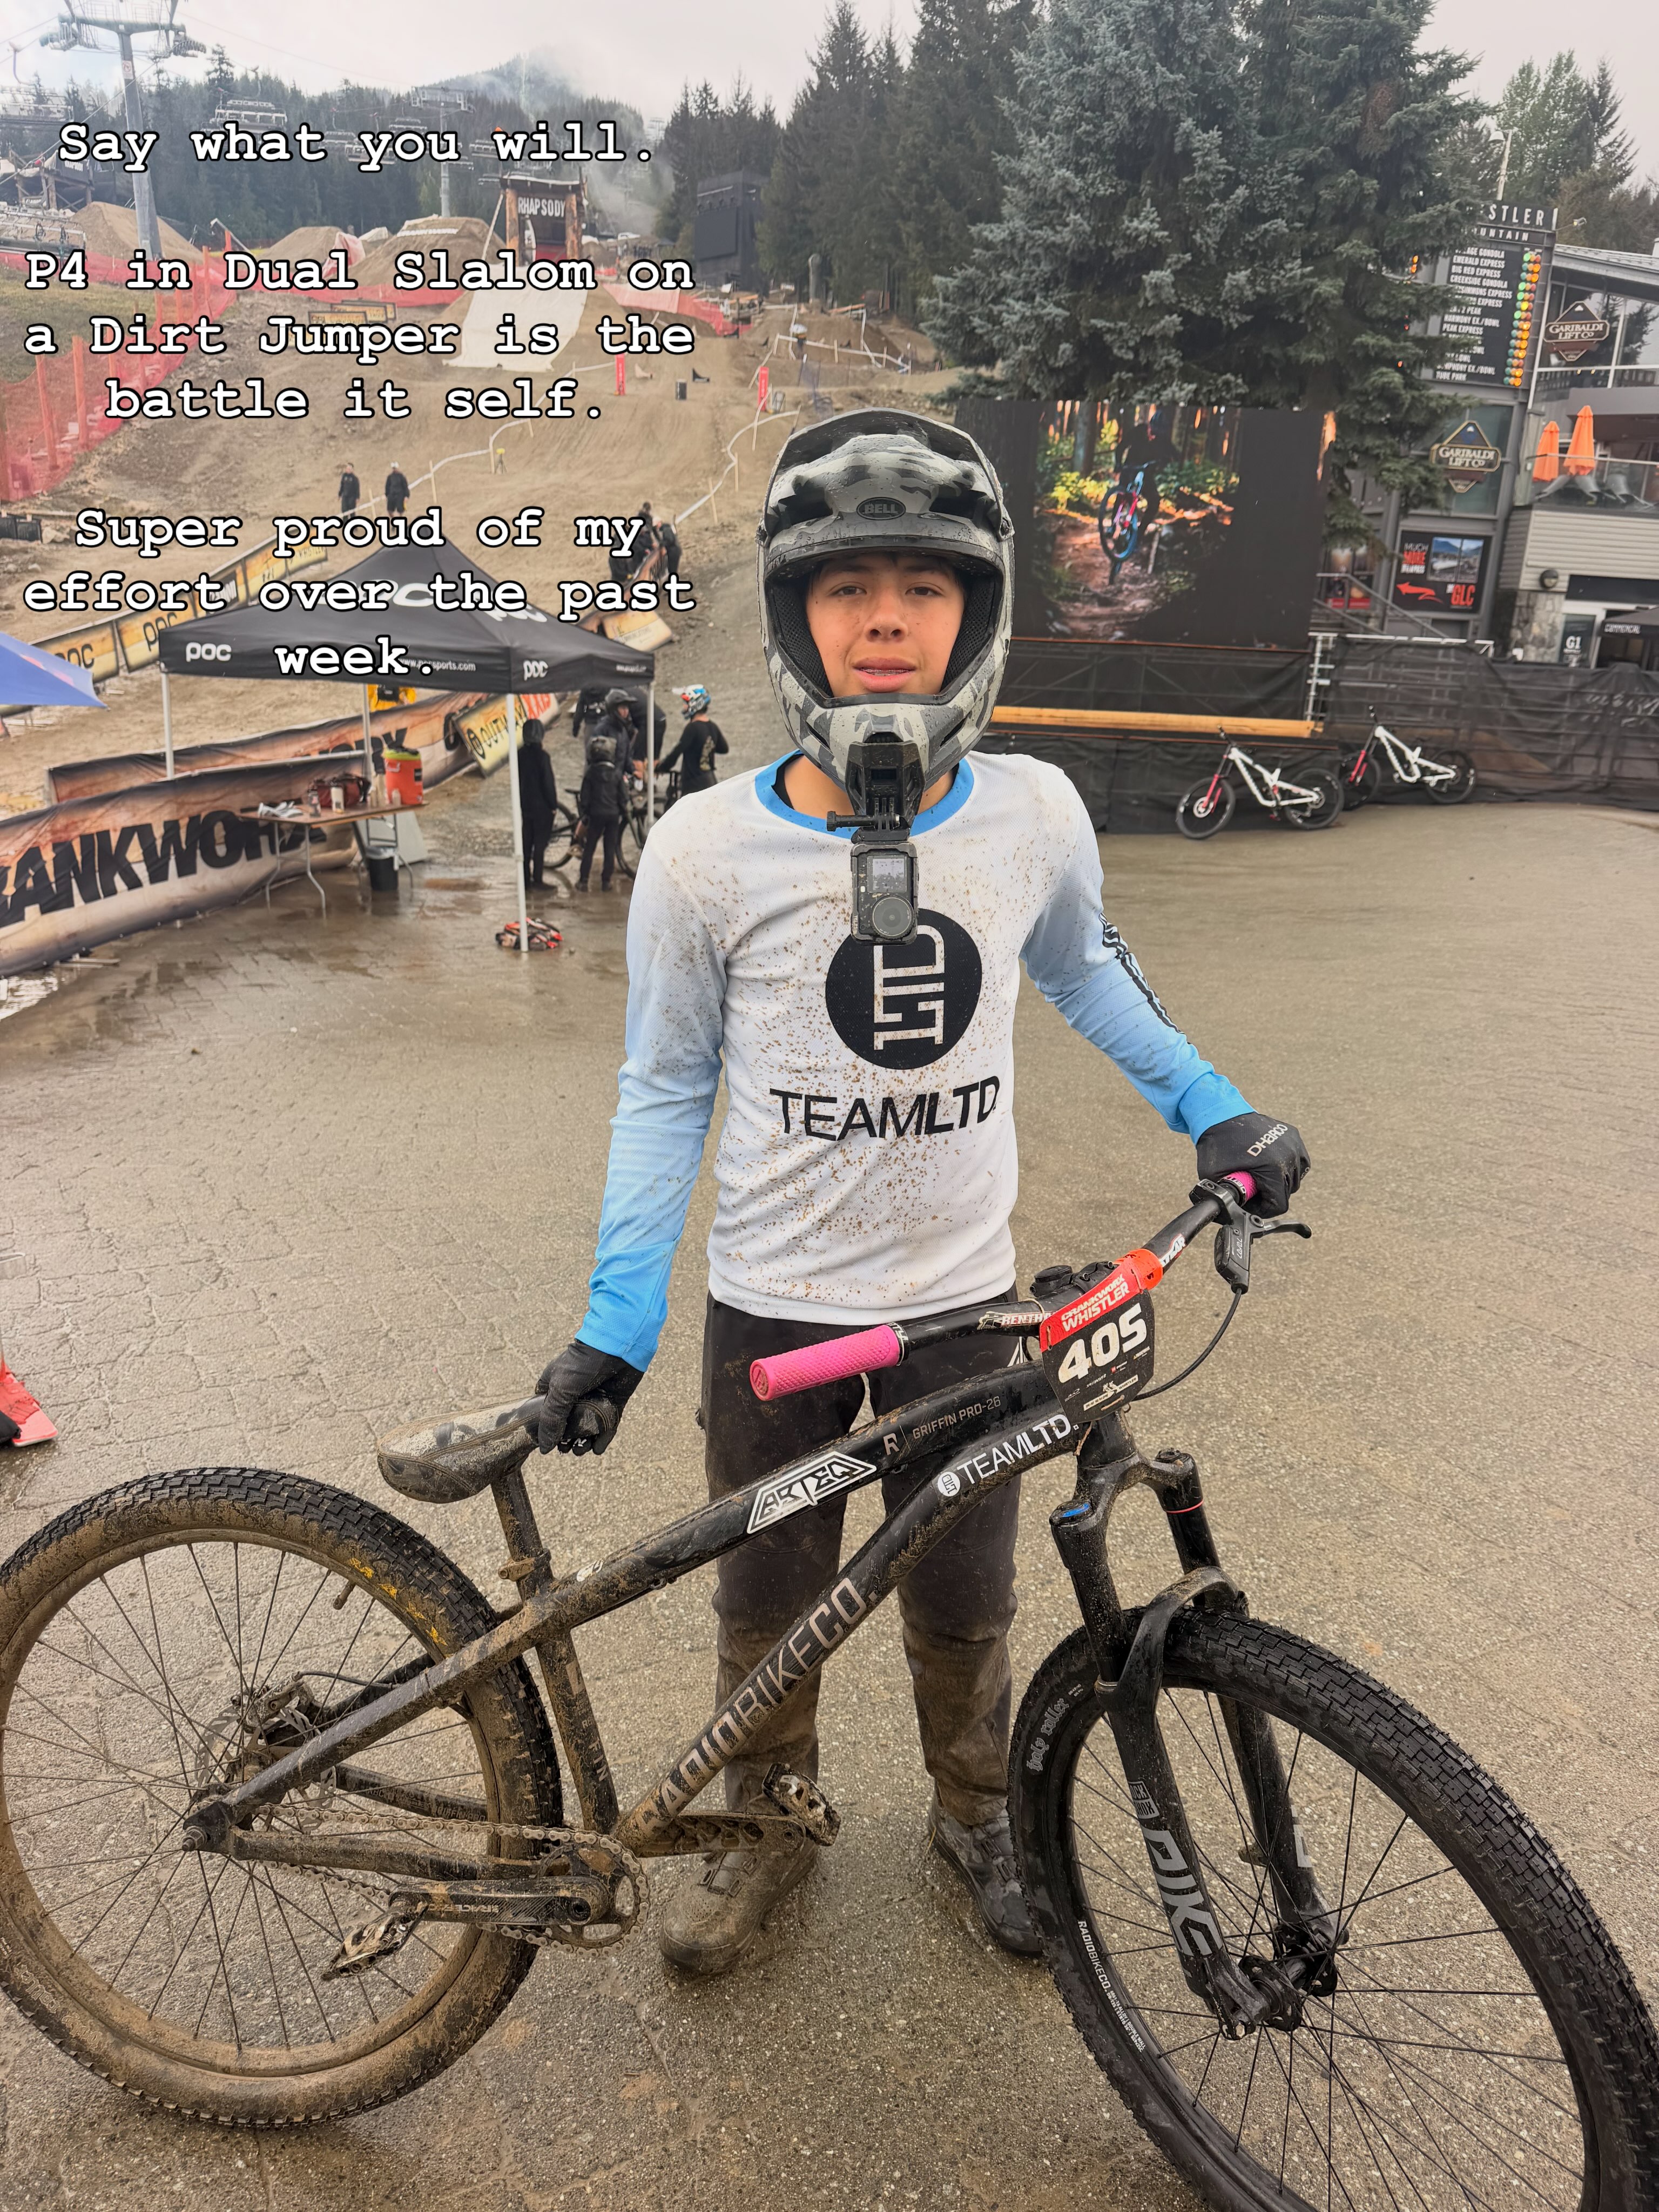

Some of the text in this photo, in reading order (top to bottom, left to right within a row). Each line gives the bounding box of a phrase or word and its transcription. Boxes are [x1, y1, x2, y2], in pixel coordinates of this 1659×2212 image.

[517, 197, 566, 218] RHAPSODY
[1548, 323, 1604, 333] GARIBALDI
[1558, 332, 1581, 340] LIFT
[862, 502, 901, 517] BELL
[1451, 584, 1476, 606] GLC
[185, 642, 232, 662] poc
[1565, 635, 1582, 650] G1
[1061, 1273, 1125, 1321] CRANKWORX
[1062, 1281, 1131, 1332] WHISTLER
[1001, 1312, 1053, 1326] RENTH
[1057, 1302, 1148, 1385] 405
[911, 1412, 957, 1440] GRIFFIN
[957, 1395, 1002, 1422] PRO-26
[1026, 1697, 1070, 1772] holy roller
[1142, 1829, 1224, 1958] PIKE
